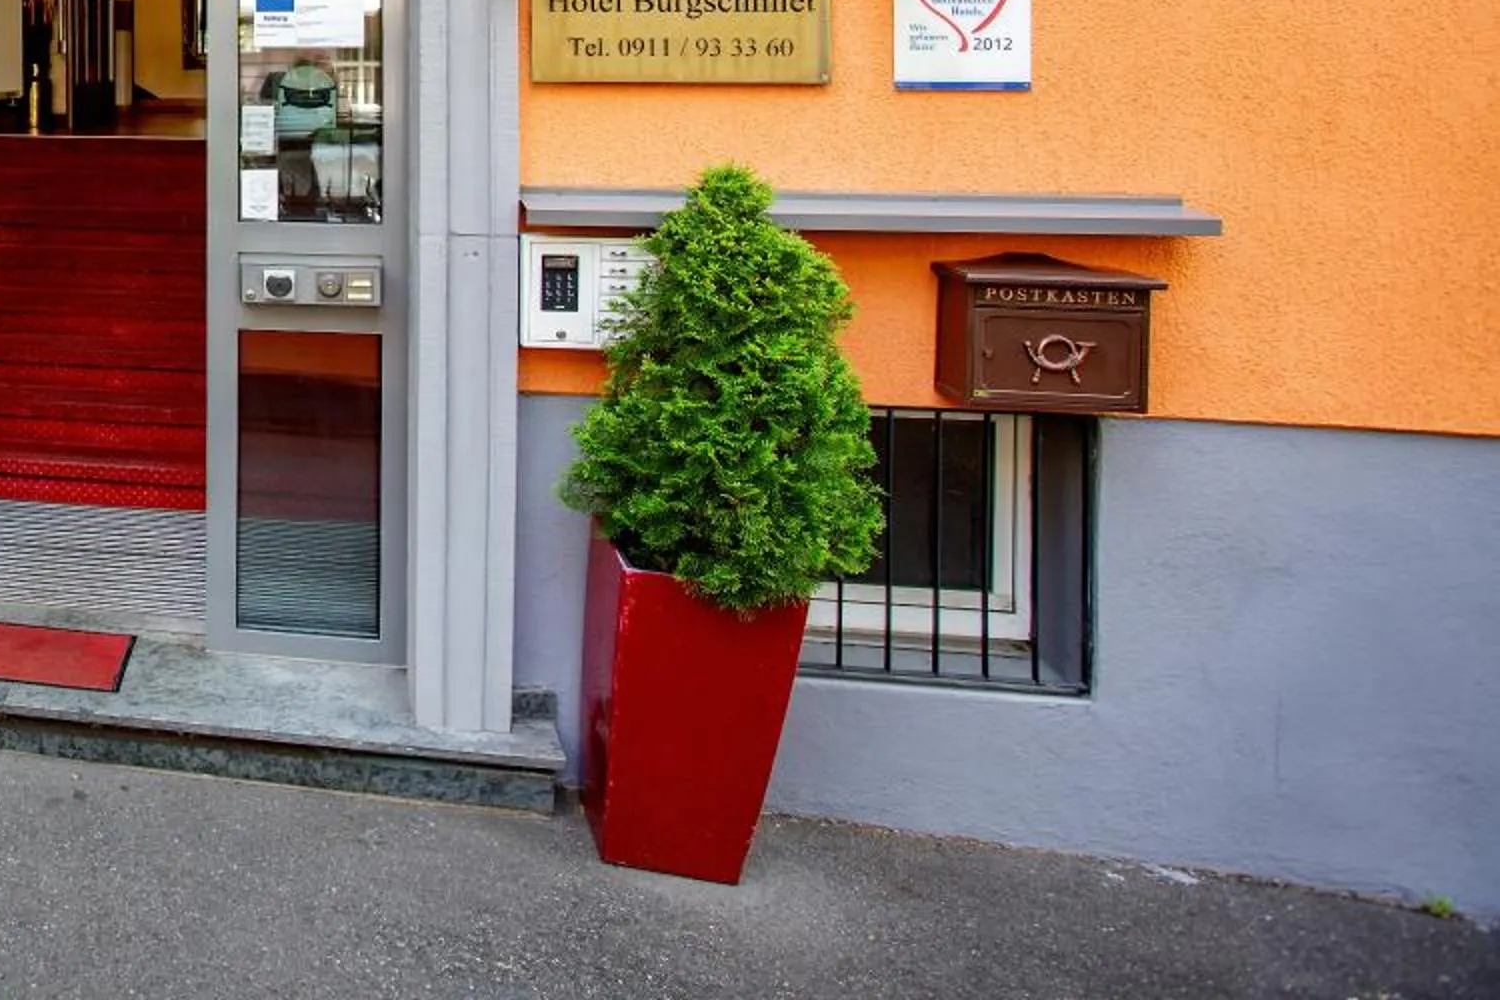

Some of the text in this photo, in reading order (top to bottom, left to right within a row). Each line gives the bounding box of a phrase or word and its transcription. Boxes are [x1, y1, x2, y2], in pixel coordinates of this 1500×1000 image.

[567, 37, 610, 57] Tel.
[617, 37, 670, 57] 0911
[695, 37, 721, 57] 93
[730, 37, 757, 57] 33
[765, 37, 794, 57] 60
[973, 37, 1013, 51] 2012
[986, 287, 1137, 305] POSTKASTEN
